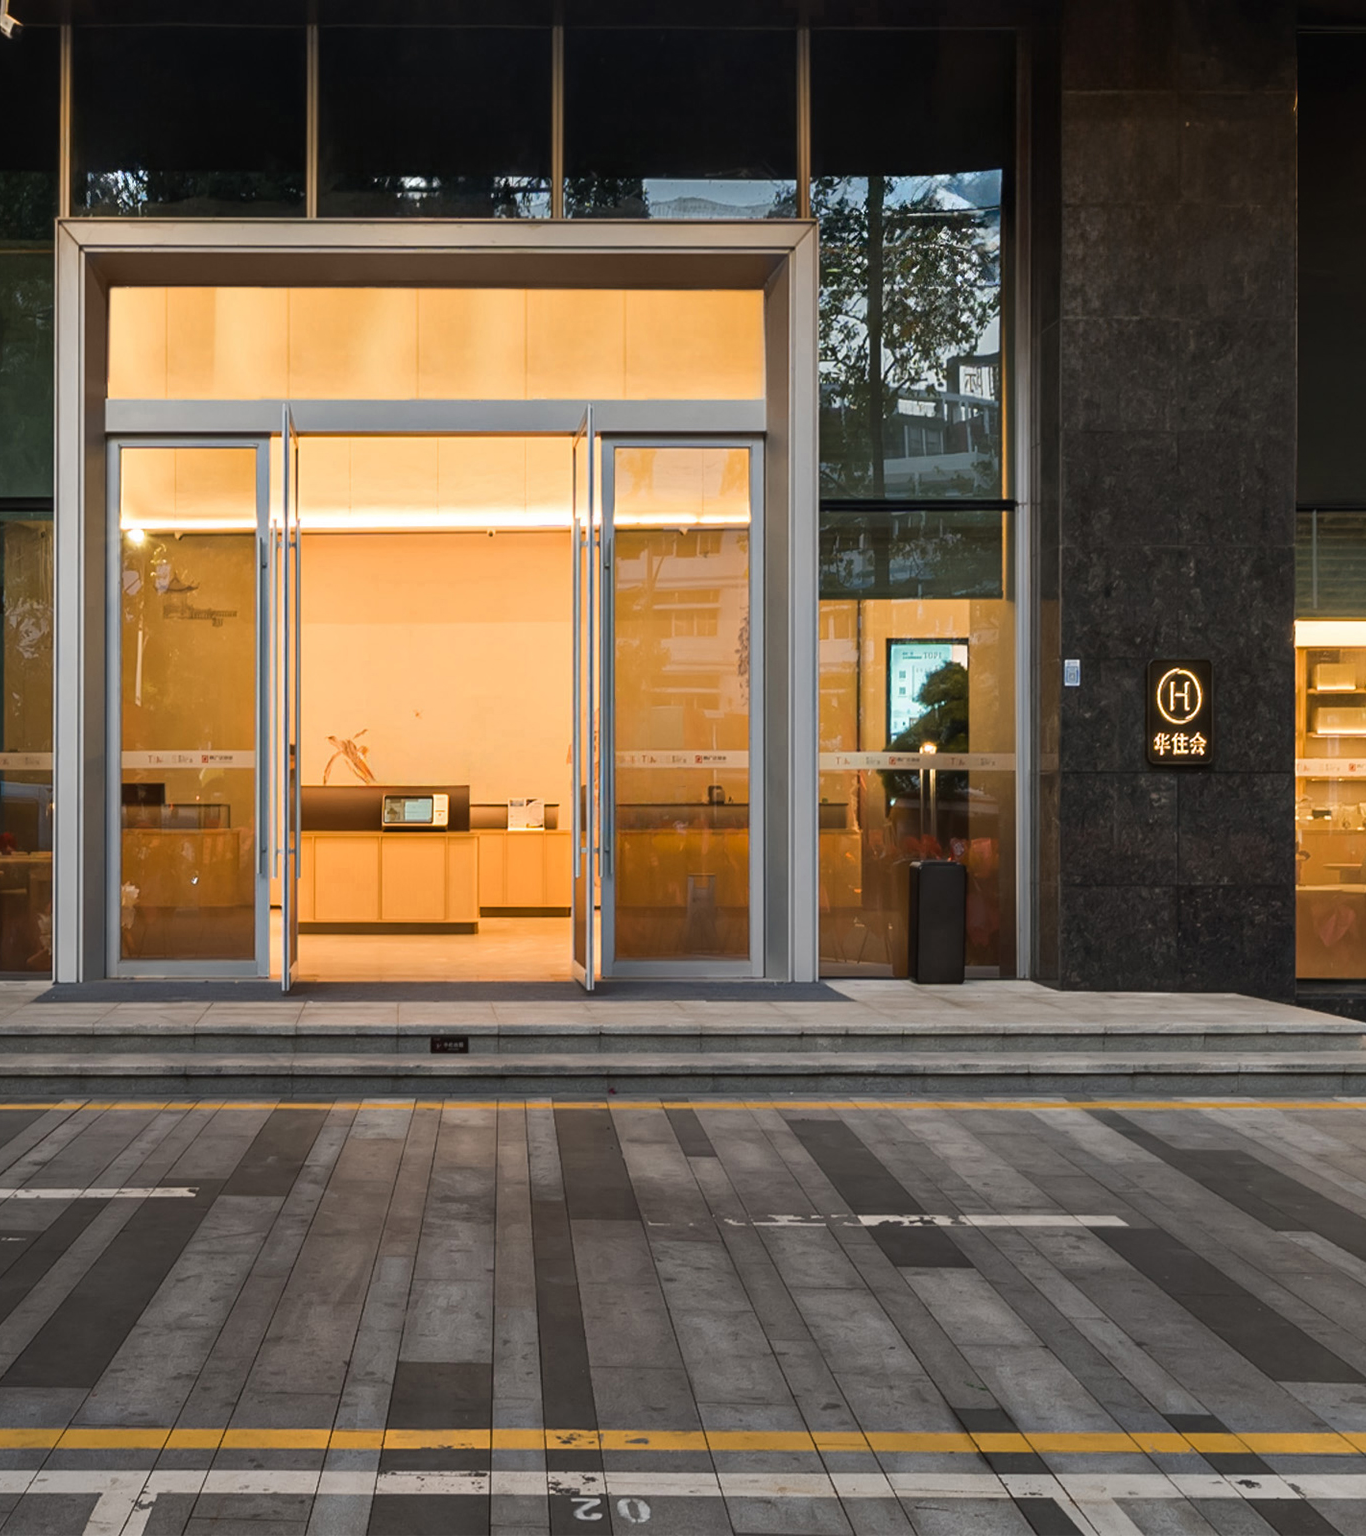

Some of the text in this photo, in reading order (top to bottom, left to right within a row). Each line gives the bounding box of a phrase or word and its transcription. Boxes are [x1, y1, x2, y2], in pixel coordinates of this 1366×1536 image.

[1153, 731, 1208, 756] 华住会
[570, 1497, 651, 1523] 02
